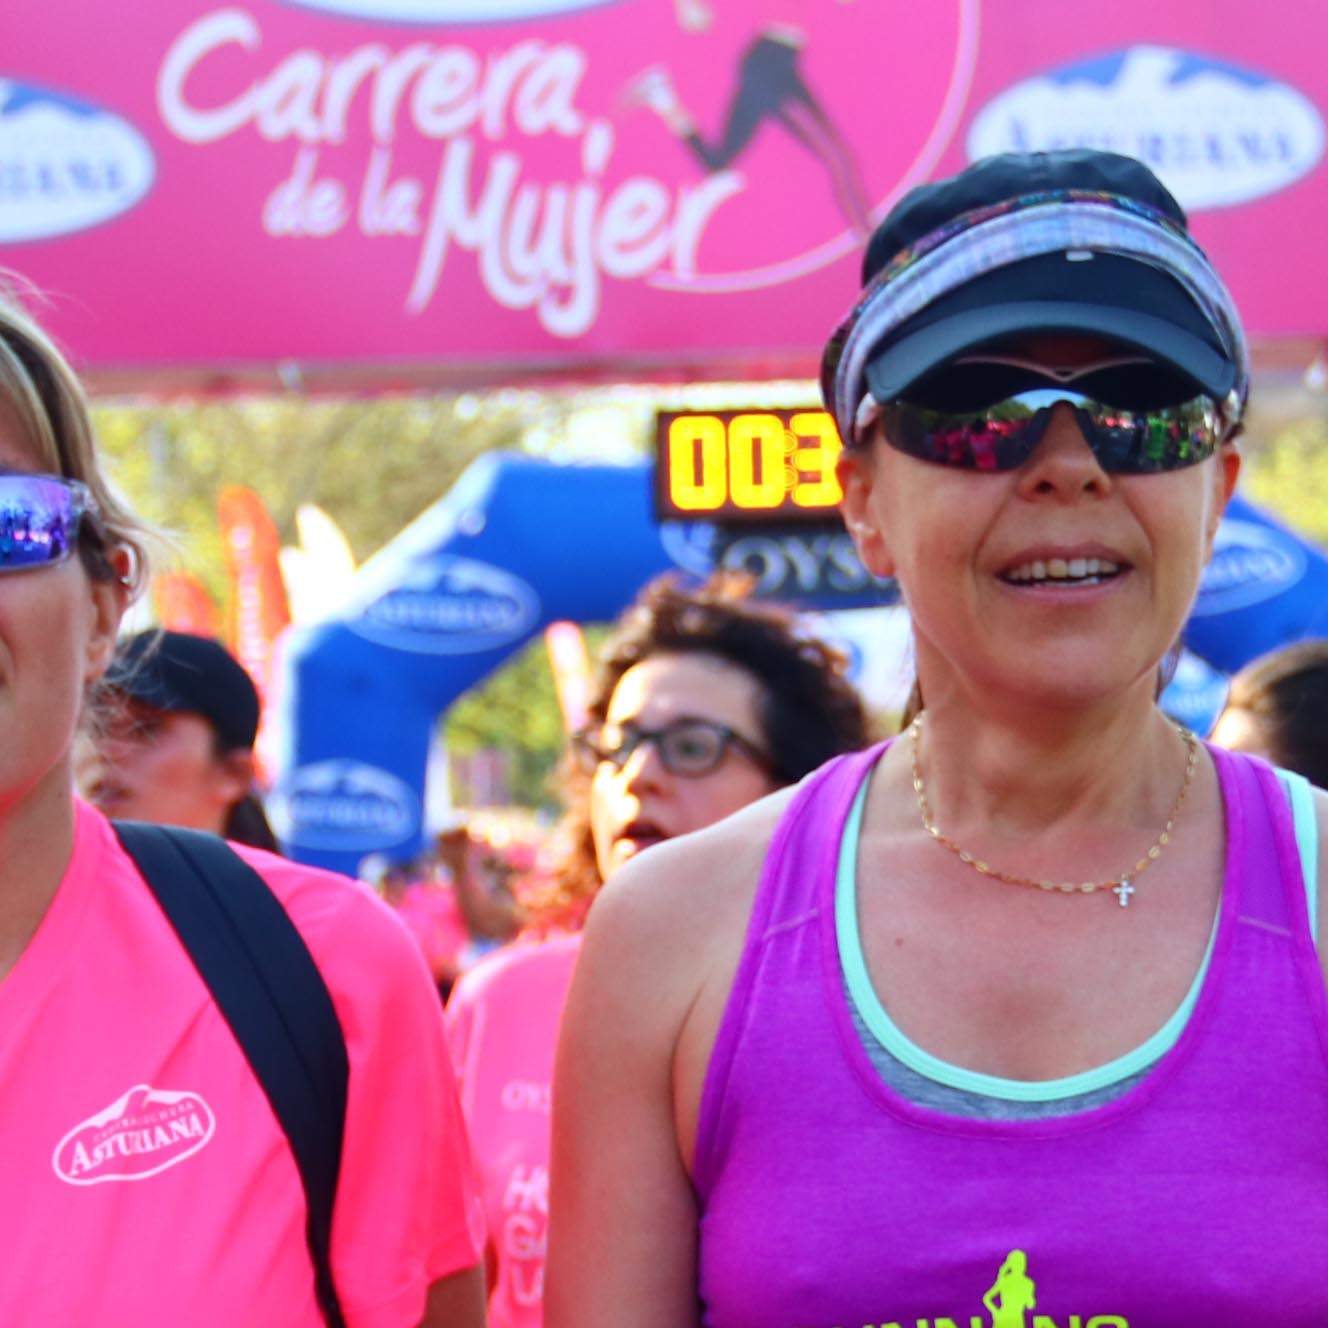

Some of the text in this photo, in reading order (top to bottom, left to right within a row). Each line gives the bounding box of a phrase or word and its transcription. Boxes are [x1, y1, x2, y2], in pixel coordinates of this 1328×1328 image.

[156, 7, 586, 144] Carrera
[262, 120, 744, 338] de la Mujer
